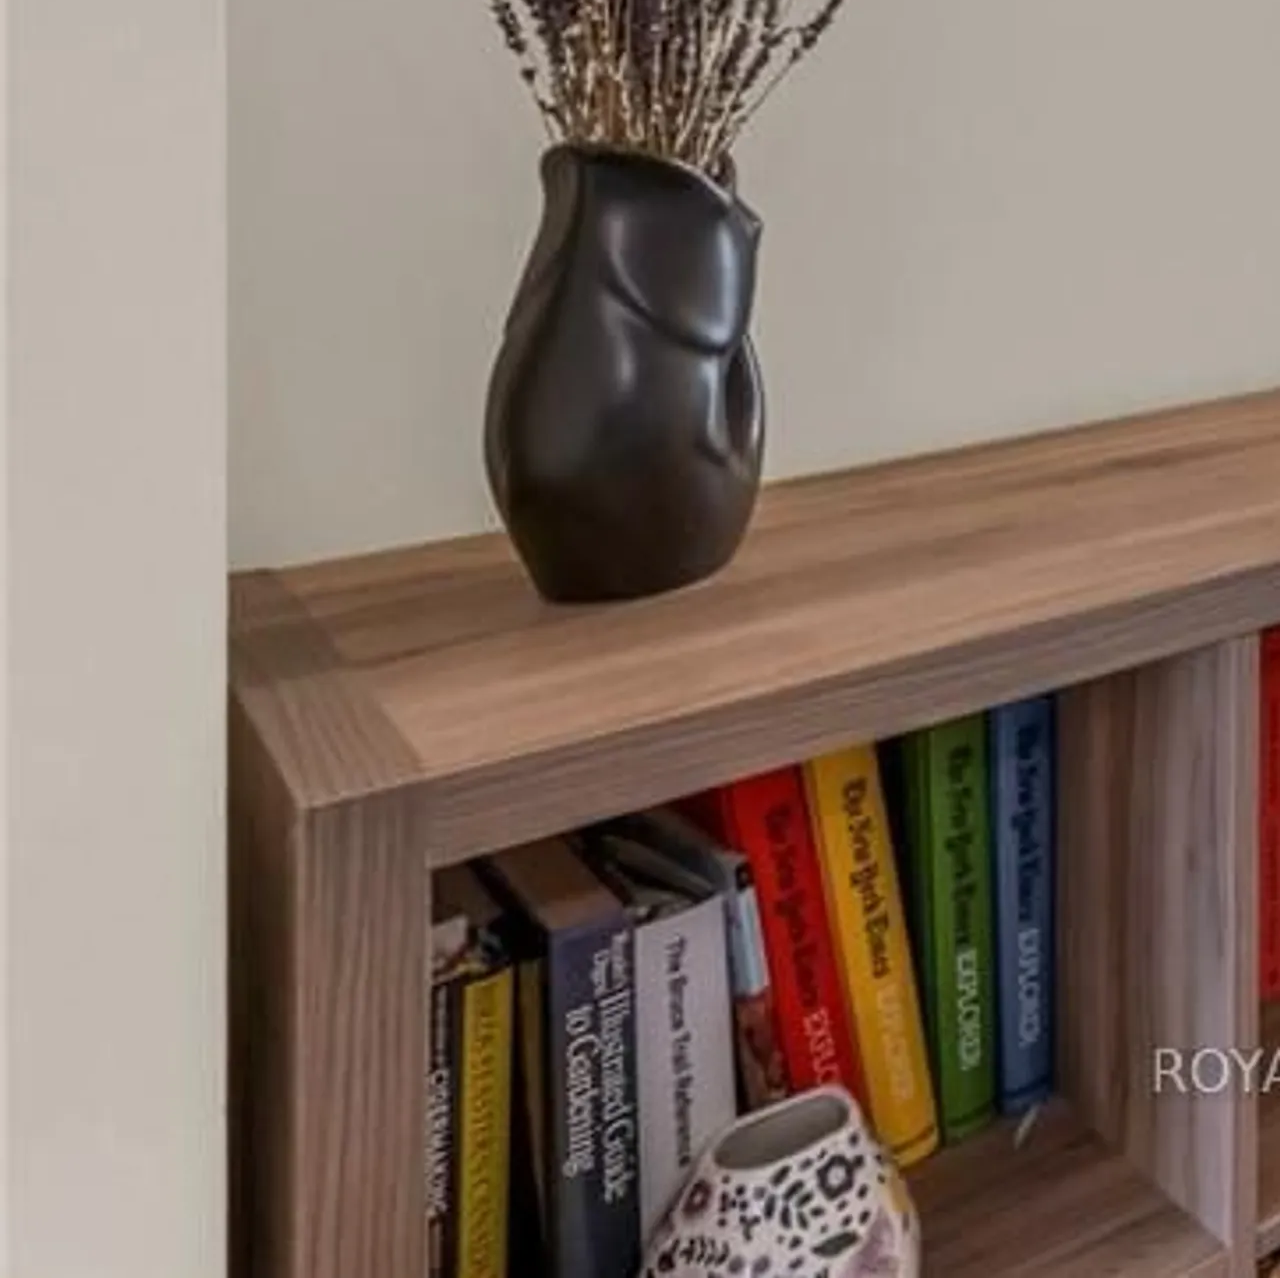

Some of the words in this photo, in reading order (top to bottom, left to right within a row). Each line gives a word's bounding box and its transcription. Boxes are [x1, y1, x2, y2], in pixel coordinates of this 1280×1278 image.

[842, 775, 872, 817] The
[848, 817, 876, 862] New
[848, 862, 885, 914] York
[665, 936, 687, 974] The
[865, 912, 893, 981] Times
[564, 1005, 593, 1033] to
[599, 989, 634, 1120] Illustrated
[671, 1031, 693, 1072] Trail
[803, 1008, 840, 1088] EXPLO
[562, 1034, 600, 1180] Gardening
[603, 1117, 635, 1204] Guide
